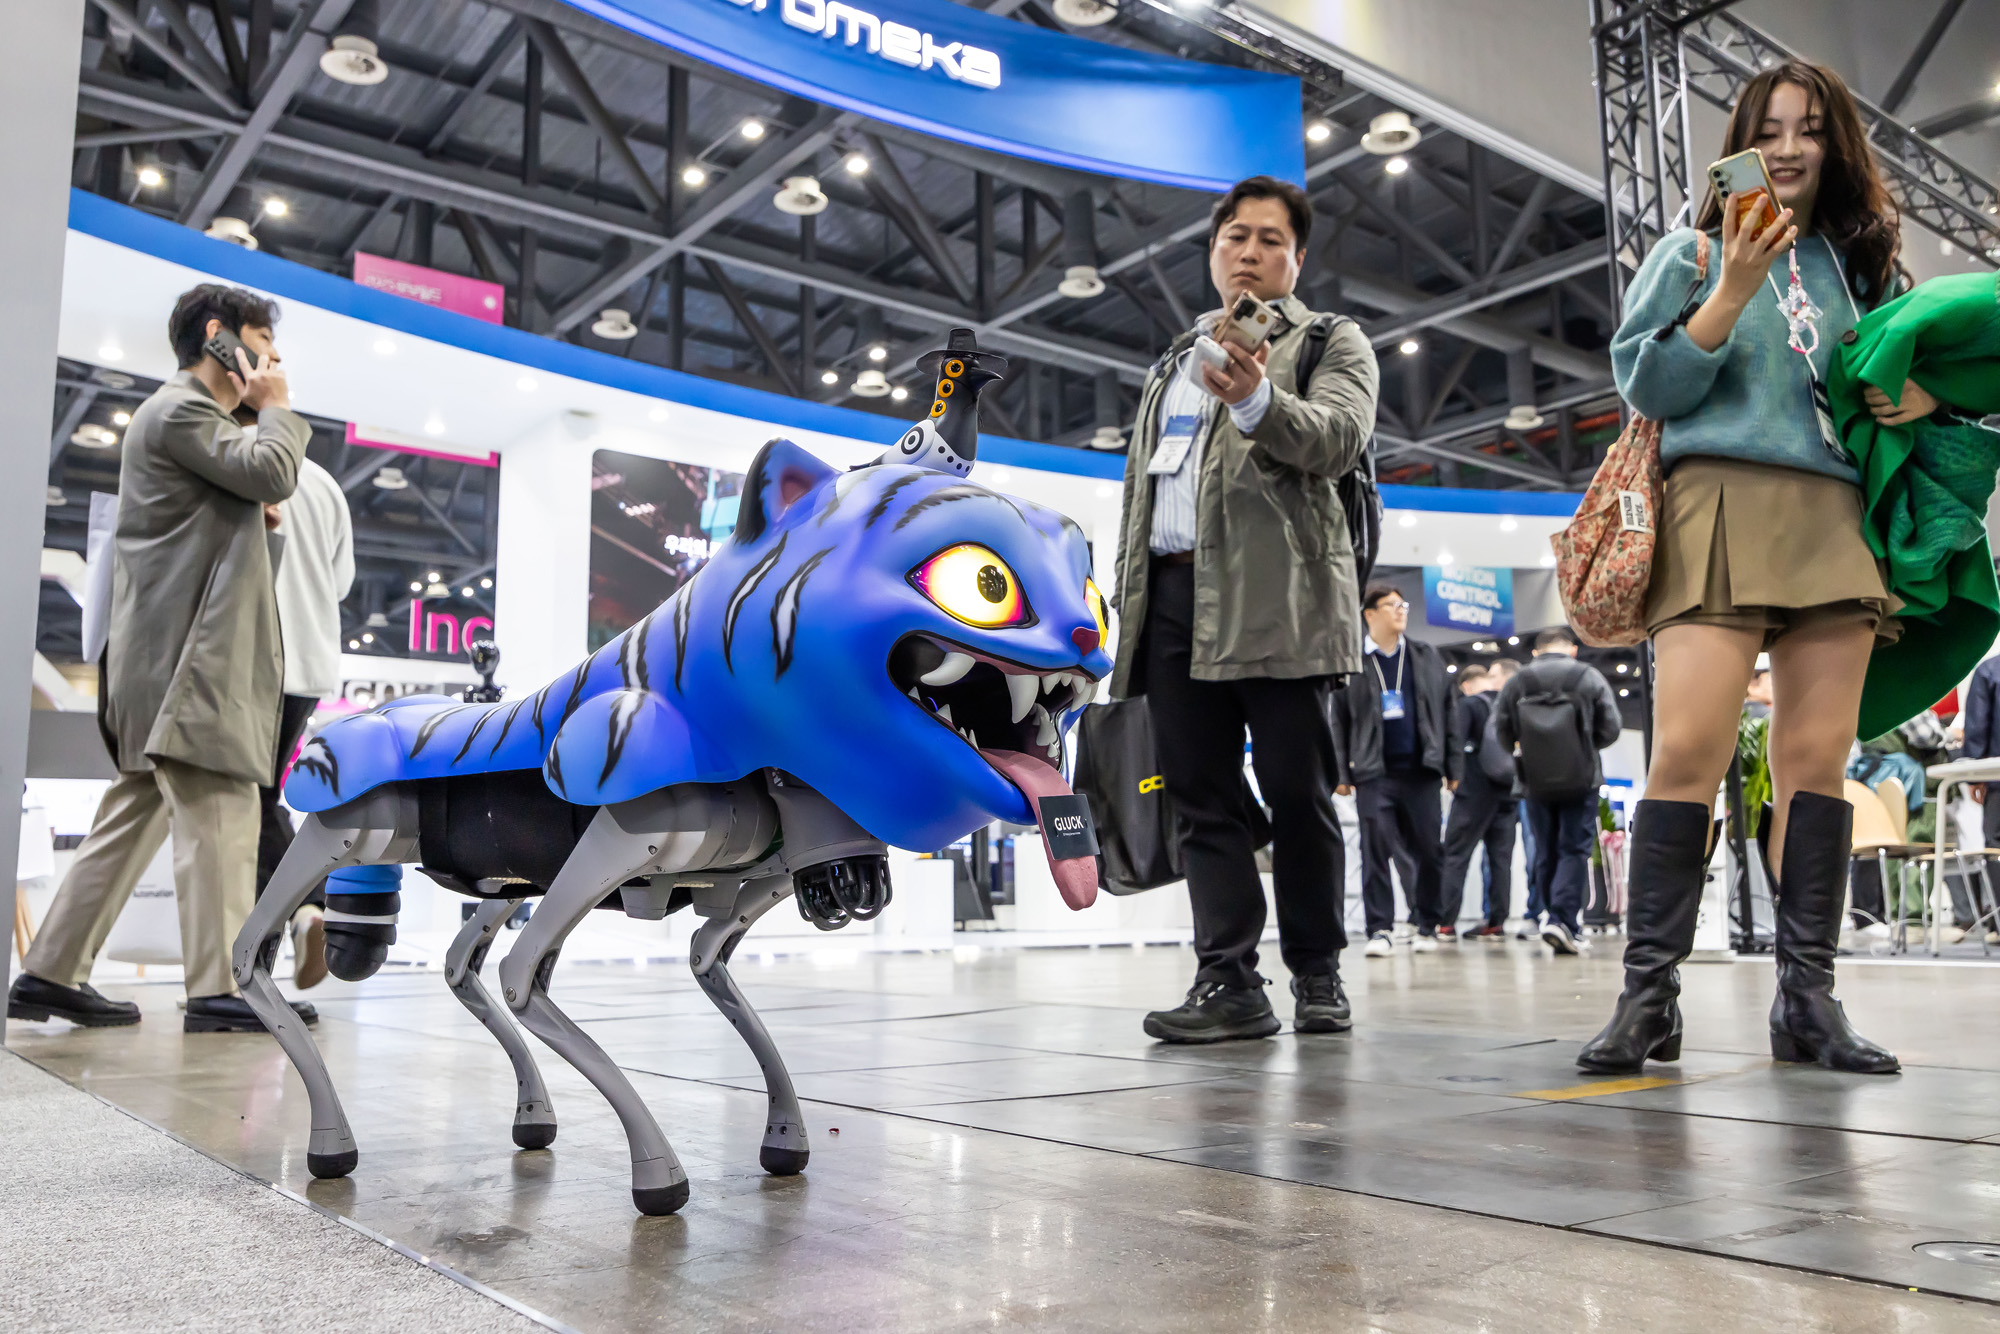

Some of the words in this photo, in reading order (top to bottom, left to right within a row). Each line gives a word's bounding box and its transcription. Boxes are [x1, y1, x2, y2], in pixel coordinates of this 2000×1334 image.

[727, 0, 1001, 90] omeka
[1436, 580, 1502, 609] CONTROL
[1448, 602, 1493, 627] SHOW
[1054, 815, 1084, 831] GLUCK
